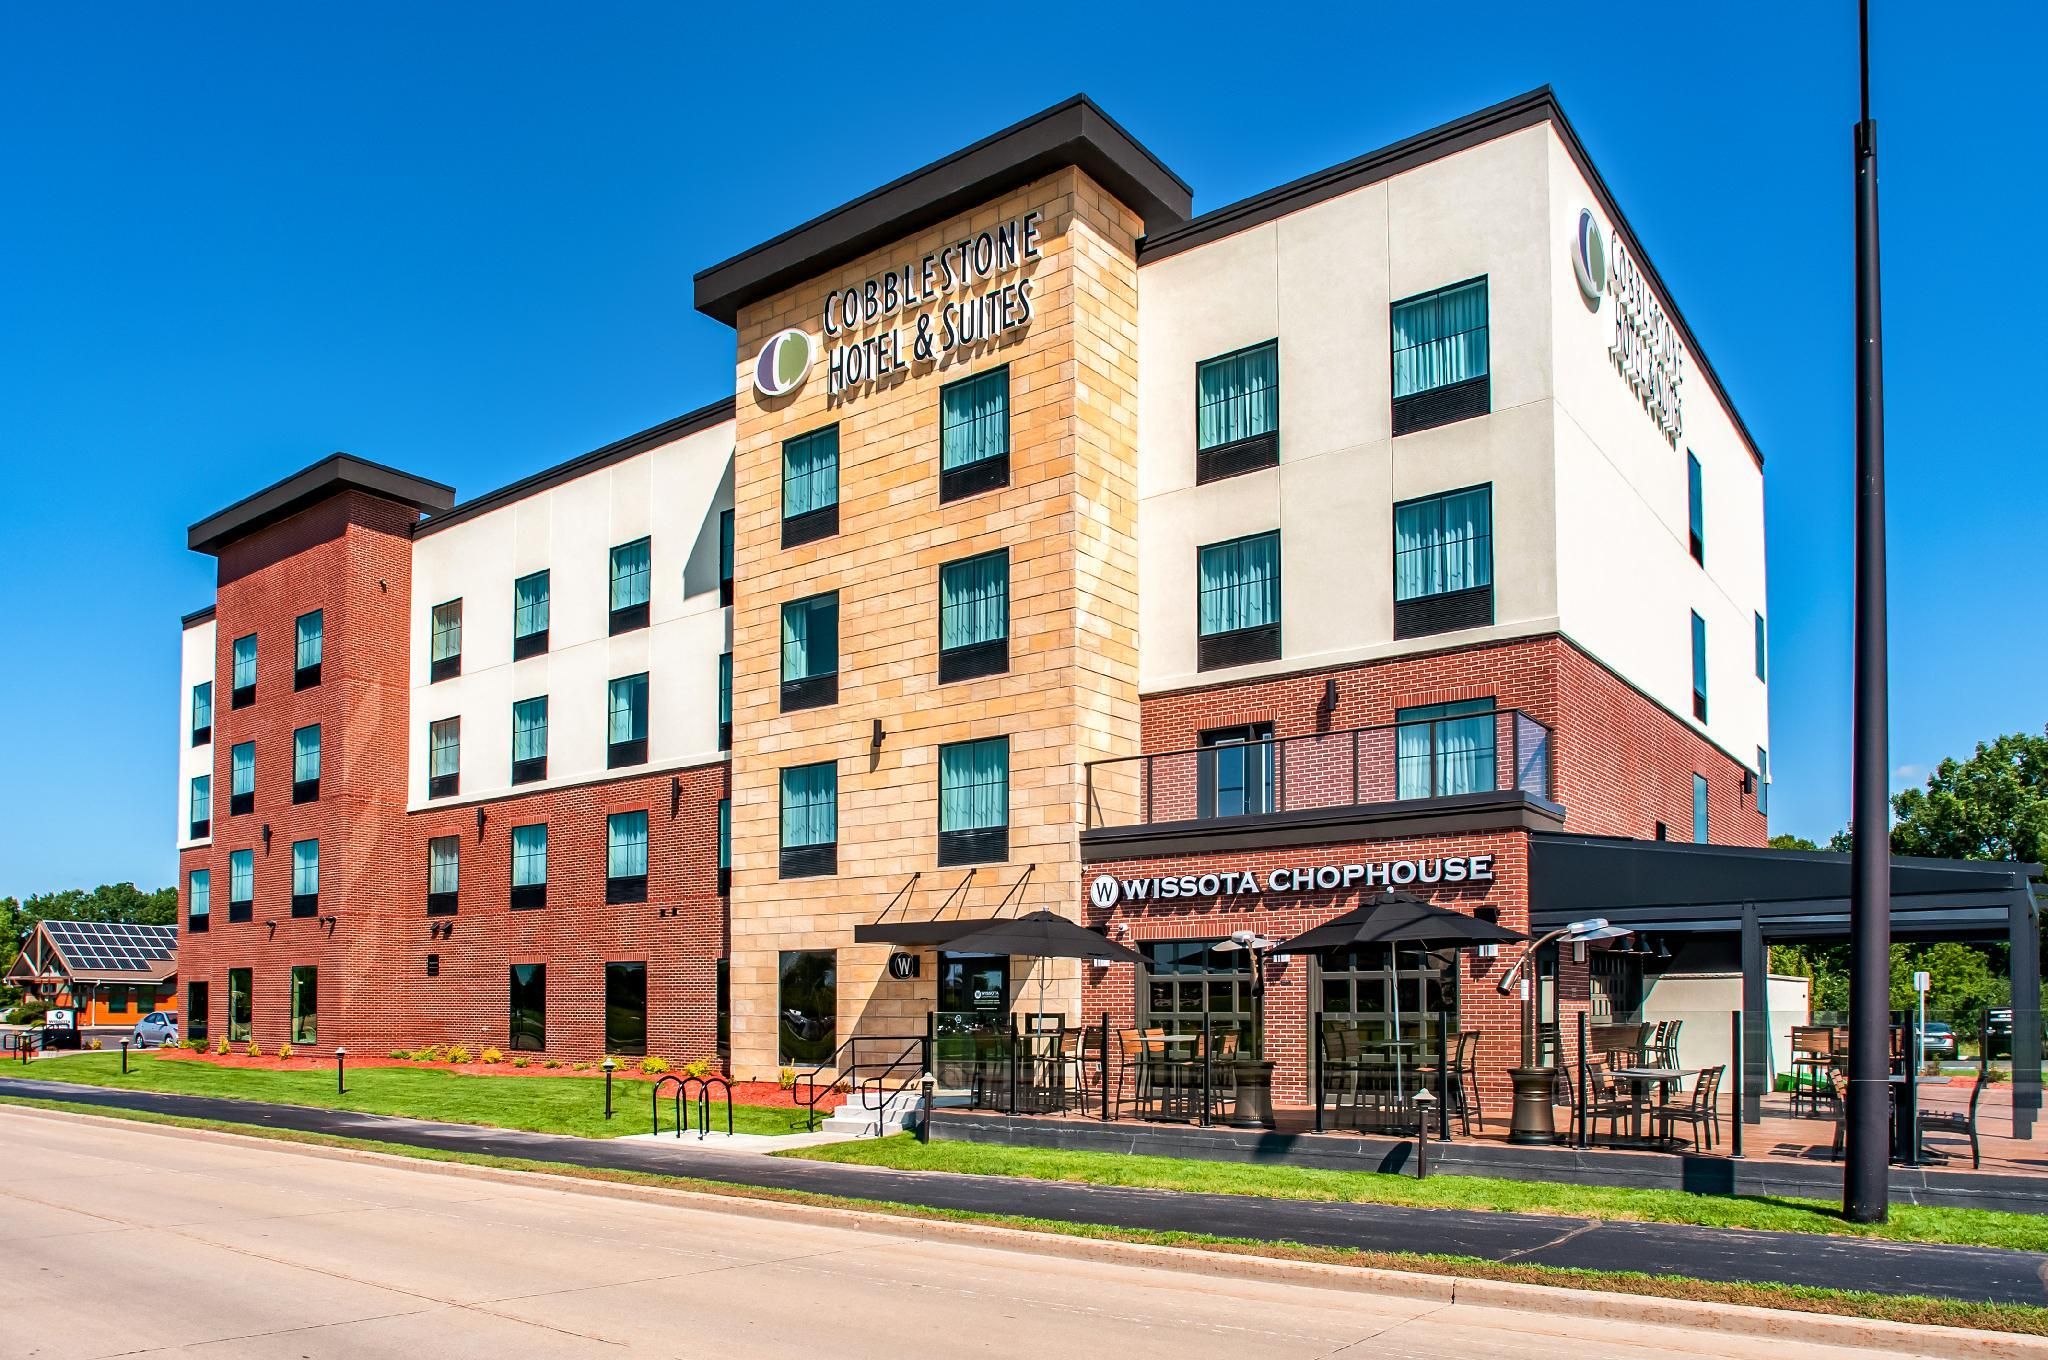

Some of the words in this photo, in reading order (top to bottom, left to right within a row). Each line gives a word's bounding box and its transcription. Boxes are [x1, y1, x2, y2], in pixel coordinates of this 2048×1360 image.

[823, 211, 1042, 338] COBBLESTONE
[828, 328, 909, 396] HOTEL
[912, 313, 937, 362] &
[942, 278, 1034, 352] SUITES
[1122, 871, 1260, 900] WISSOTA
[1268, 854, 1493, 891] CHOPHOUSE
[897, 957, 911, 975] W
